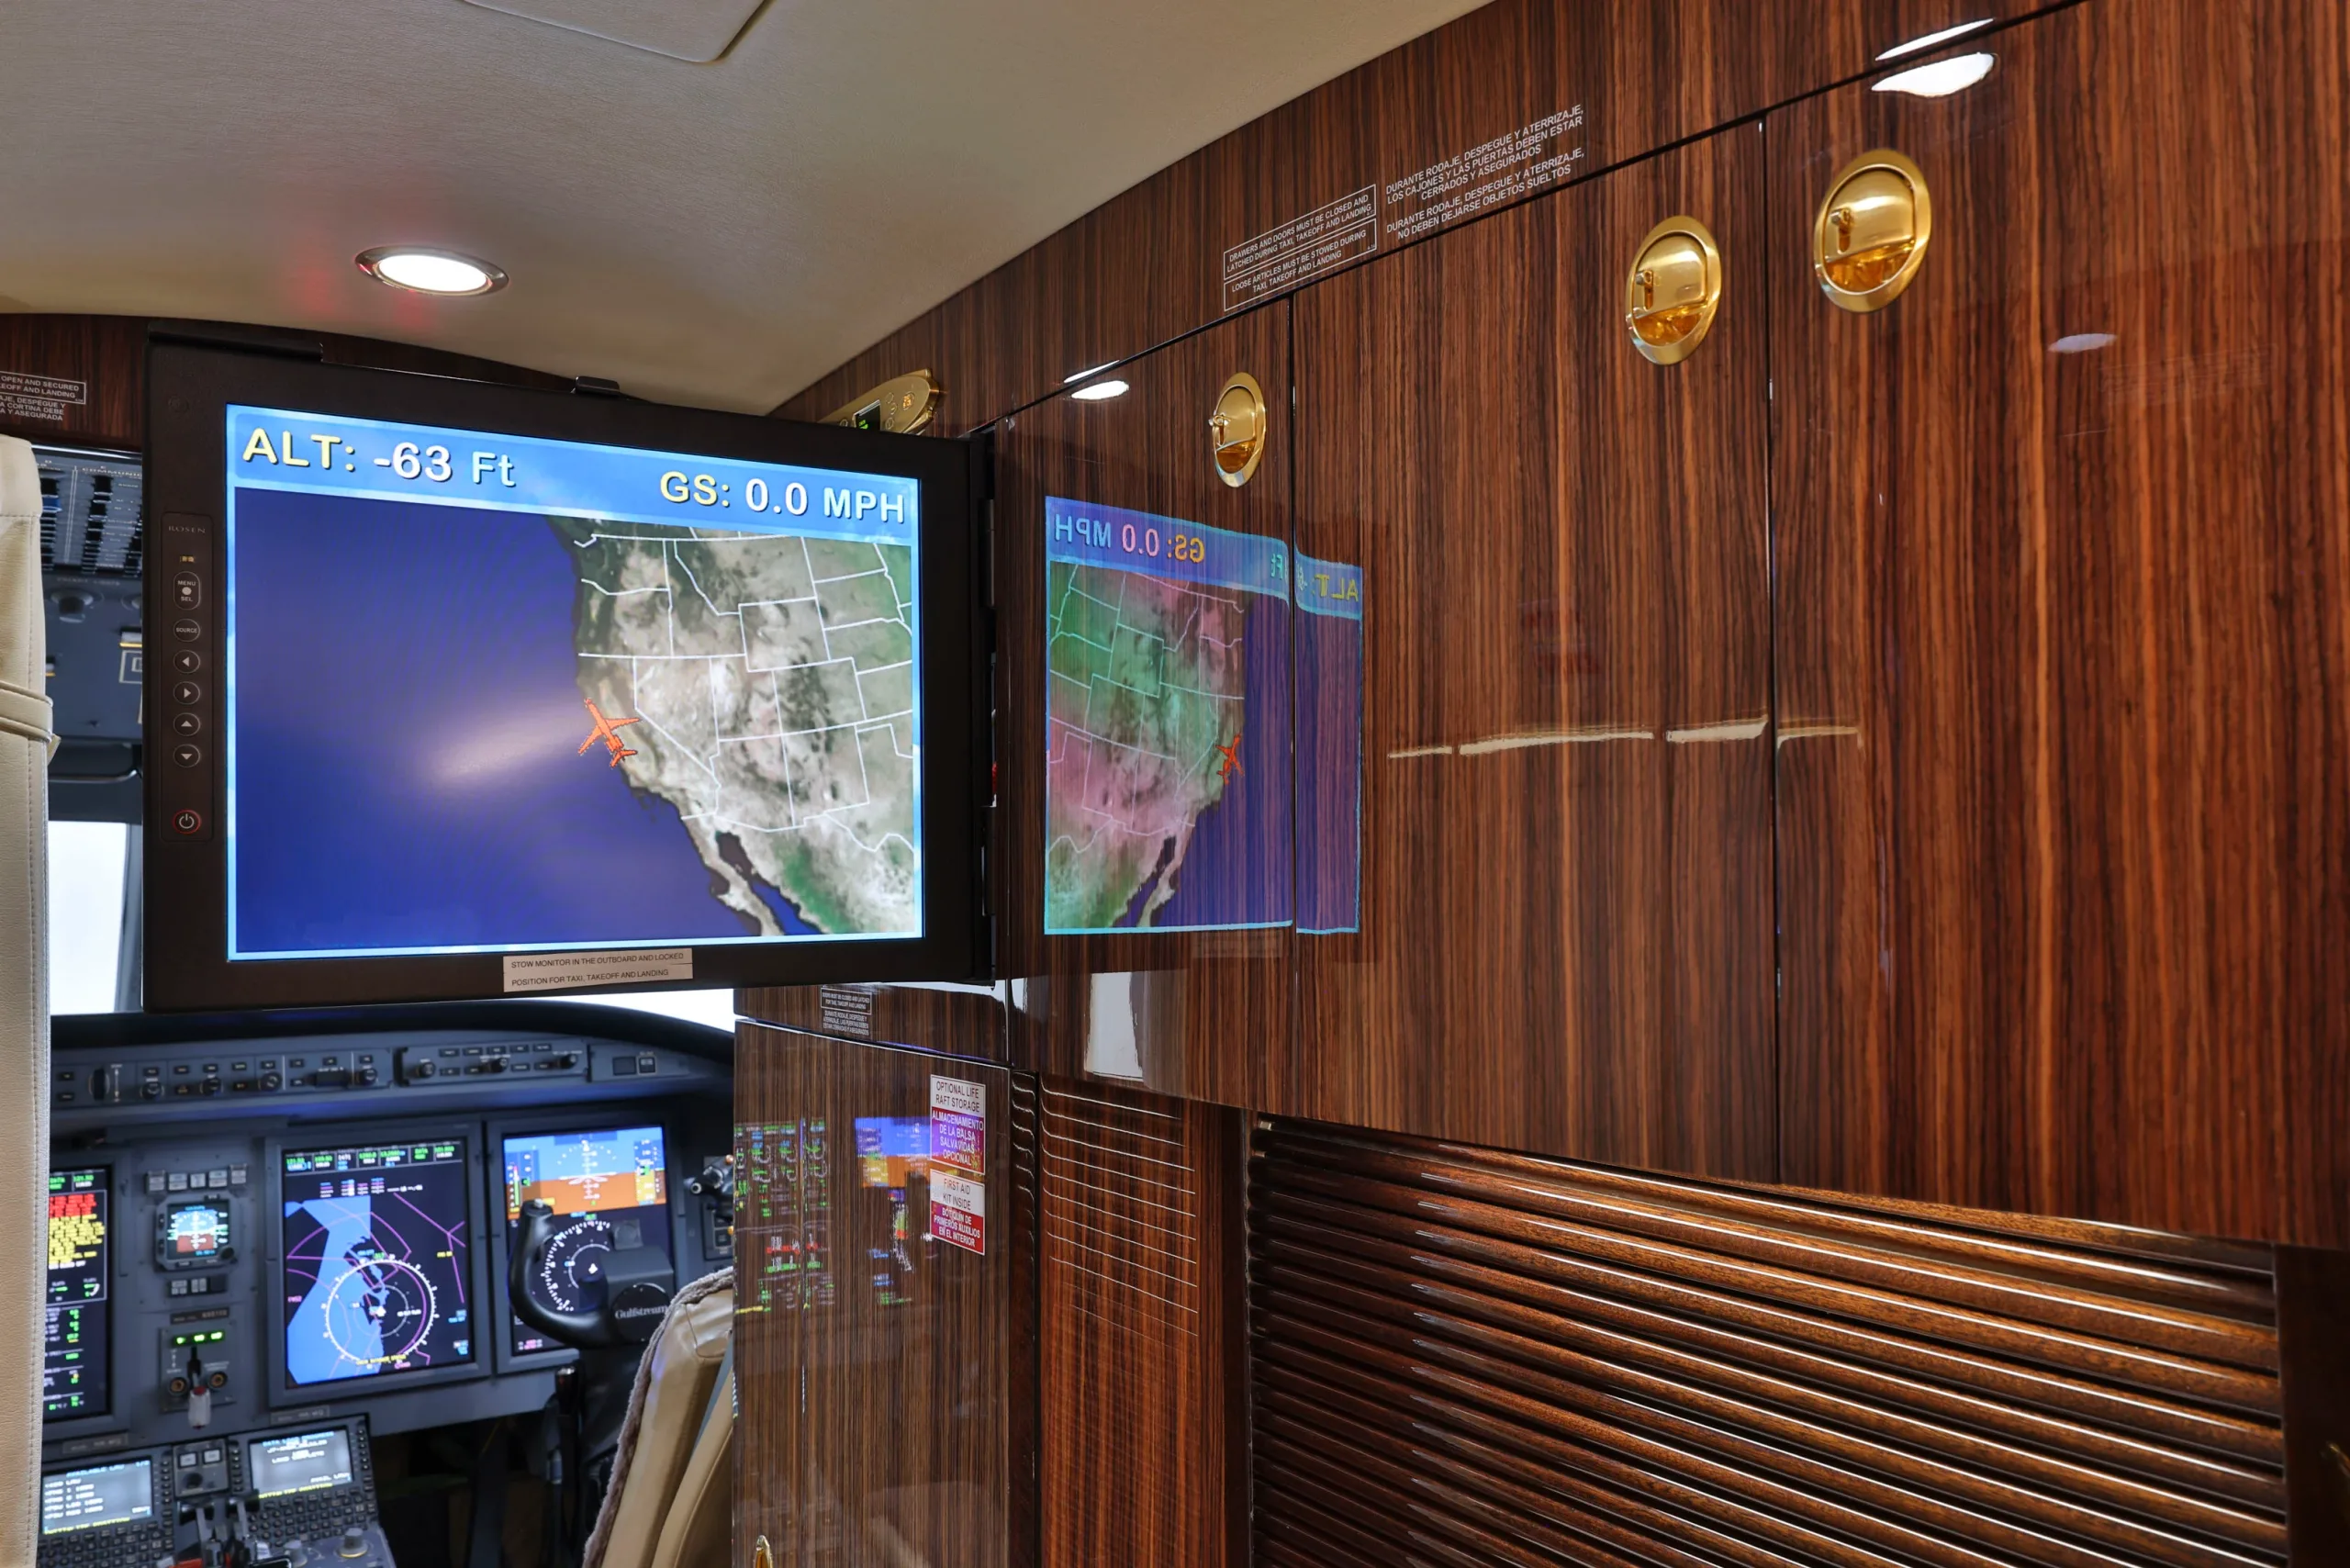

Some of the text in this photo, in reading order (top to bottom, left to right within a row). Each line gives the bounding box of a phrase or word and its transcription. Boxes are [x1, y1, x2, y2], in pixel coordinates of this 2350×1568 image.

[1386, 105, 1583, 195] DURANTE RODAJE, DESPEGUE Y ATERRIZAJE,
[1388, 192, 1403, 205] LOS
[1405, 174, 1443, 196] CAJONES
[1454, 163, 1470, 176] LAS
[1472, 143, 1513, 168] PUERTAS
[1516, 132, 1547, 150] DEBEN
[1550, 117, 1583, 136] ESTAR
[1421, 144, 1541, 200] CERRADOS Y ASEGURADOS
[1387, 148, 1583, 233] DURANTE RODAJE, DESPEGUE Y ATERRIZAJE,
[1398, 164, 1571, 240] NO DEBEN DEJARSE OBJETOS SUELTOS
[1229, 242, 1258, 262] DRAWERS
[1259, 238, 1271, 251] AND
[1273, 227, 1294, 243] DOORS
[1296, 219, 1314, 234] MUST
[1315, 214, 1324, 224] BE
[1326, 202, 1351, 221] CLOSED
[1354, 195, 1368, 207] AND
[1227, 204, 1371, 272] LATCHED DURING TAXI, TAKEOFF AND LANDING
[1232, 230, 1366, 292] LOOSE ARTICLES MUST BE STOWED DURING
[1270, 268, 1296, 287] TAKEOFF
[1298, 263, 1311, 274] AND
[1314, 251, 1341, 268] LANDING
[1, 375, 22, 384] OPEN
[43, 382, 79, 391] SECURED
[42, 389, 75, 398] LANDING
[7, 403, 41, 411] CORTINA
[17, 398, 59, 408] DESPEGUE
[15, 410, 62, 420] ASEGURADA
[241, 427, 516, 488] ALT: -63 Ft
[659, 470, 905, 524] GS: 0.0 MPH
[535, 959, 571, 968] MONITOR
[598, 955, 637, 964] OUTBOARD
[936, 1081, 979, 1098] OPTIONAL LIFE
[936, 1094, 979, 1112] RAFT STORAGE
[932, 1111, 983, 1131] ALMACENAMIENTO
[940, 1125, 975, 1141] DE LA BALSA
[940, 1137, 974, 1153] SALVAVIDAS
[944, 1149, 971, 1165] OPCIONAL
[944, 1179, 970, 1194] FIRST AID
[943, 1193, 970, 1210] KIT INSIDE
[934, 1215, 980, 1238] PRIMEROS AUXILIOS
[965, 1215, 971, 1225] DE
[939, 1227, 975, 1248] EN EL INTERIOR
[615, 1305, 668, 1319] Gulfstream
